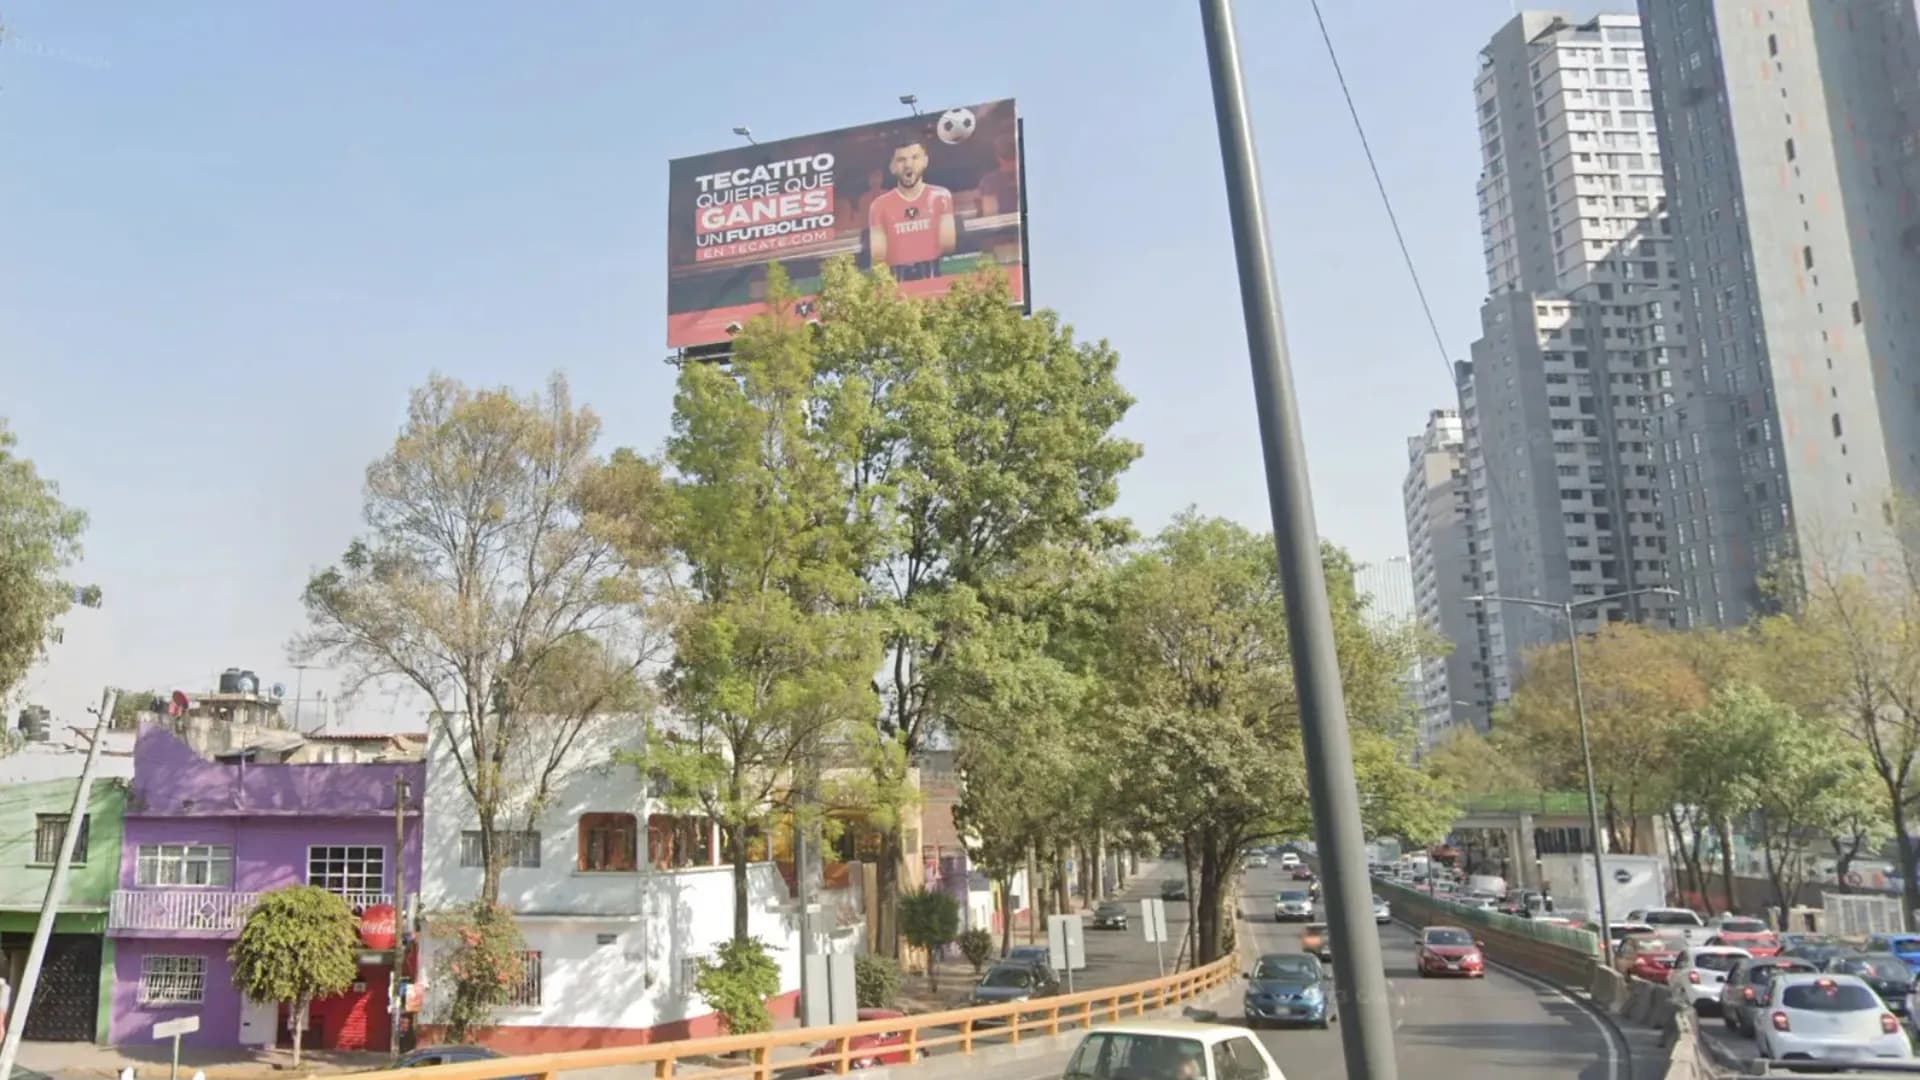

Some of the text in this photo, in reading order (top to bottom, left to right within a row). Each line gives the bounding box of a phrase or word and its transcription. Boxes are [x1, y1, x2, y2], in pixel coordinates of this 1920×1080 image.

[695, 153, 834, 192] TECATITO
[697, 172, 834, 208] QUIERE QUE
[702, 190, 827, 229] GANES
[697, 214, 834, 247] UN FUTBOLITO
[703, 231, 827, 258] EN TECATE.COM
